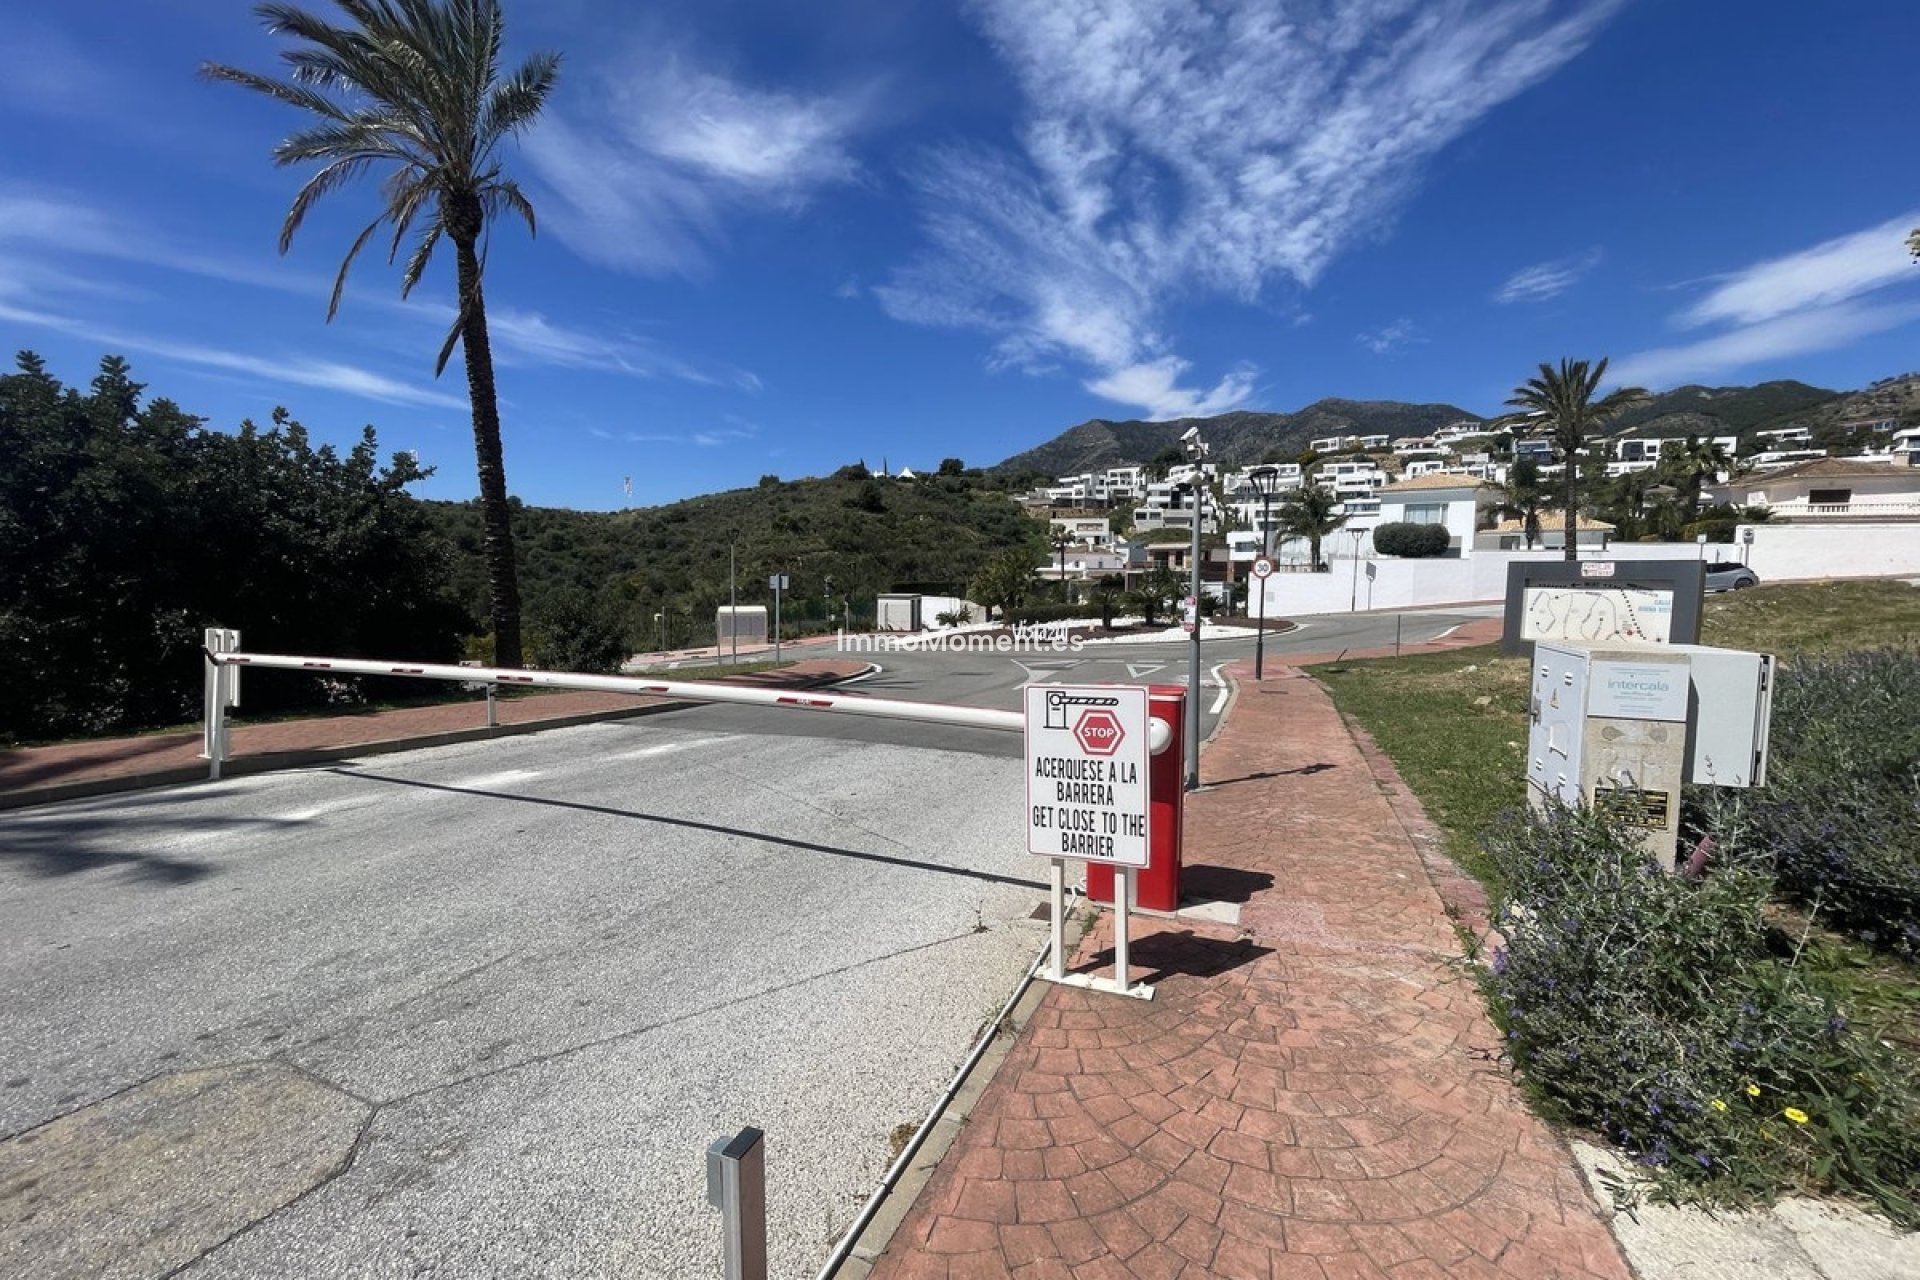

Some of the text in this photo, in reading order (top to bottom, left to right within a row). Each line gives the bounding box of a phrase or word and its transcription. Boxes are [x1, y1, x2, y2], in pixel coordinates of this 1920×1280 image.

[1257, 562, 1270, 573] 30
[1084, 727, 1115, 739] STOP
[1035, 757, 1137, 784] ACERQUESE A LA
[1057, 781, 1115, 806] BARRERA
[1033, 805, 1145, 837] GET CLOSE TO THE
[1061, 832, 1114, 857] BARRIER
